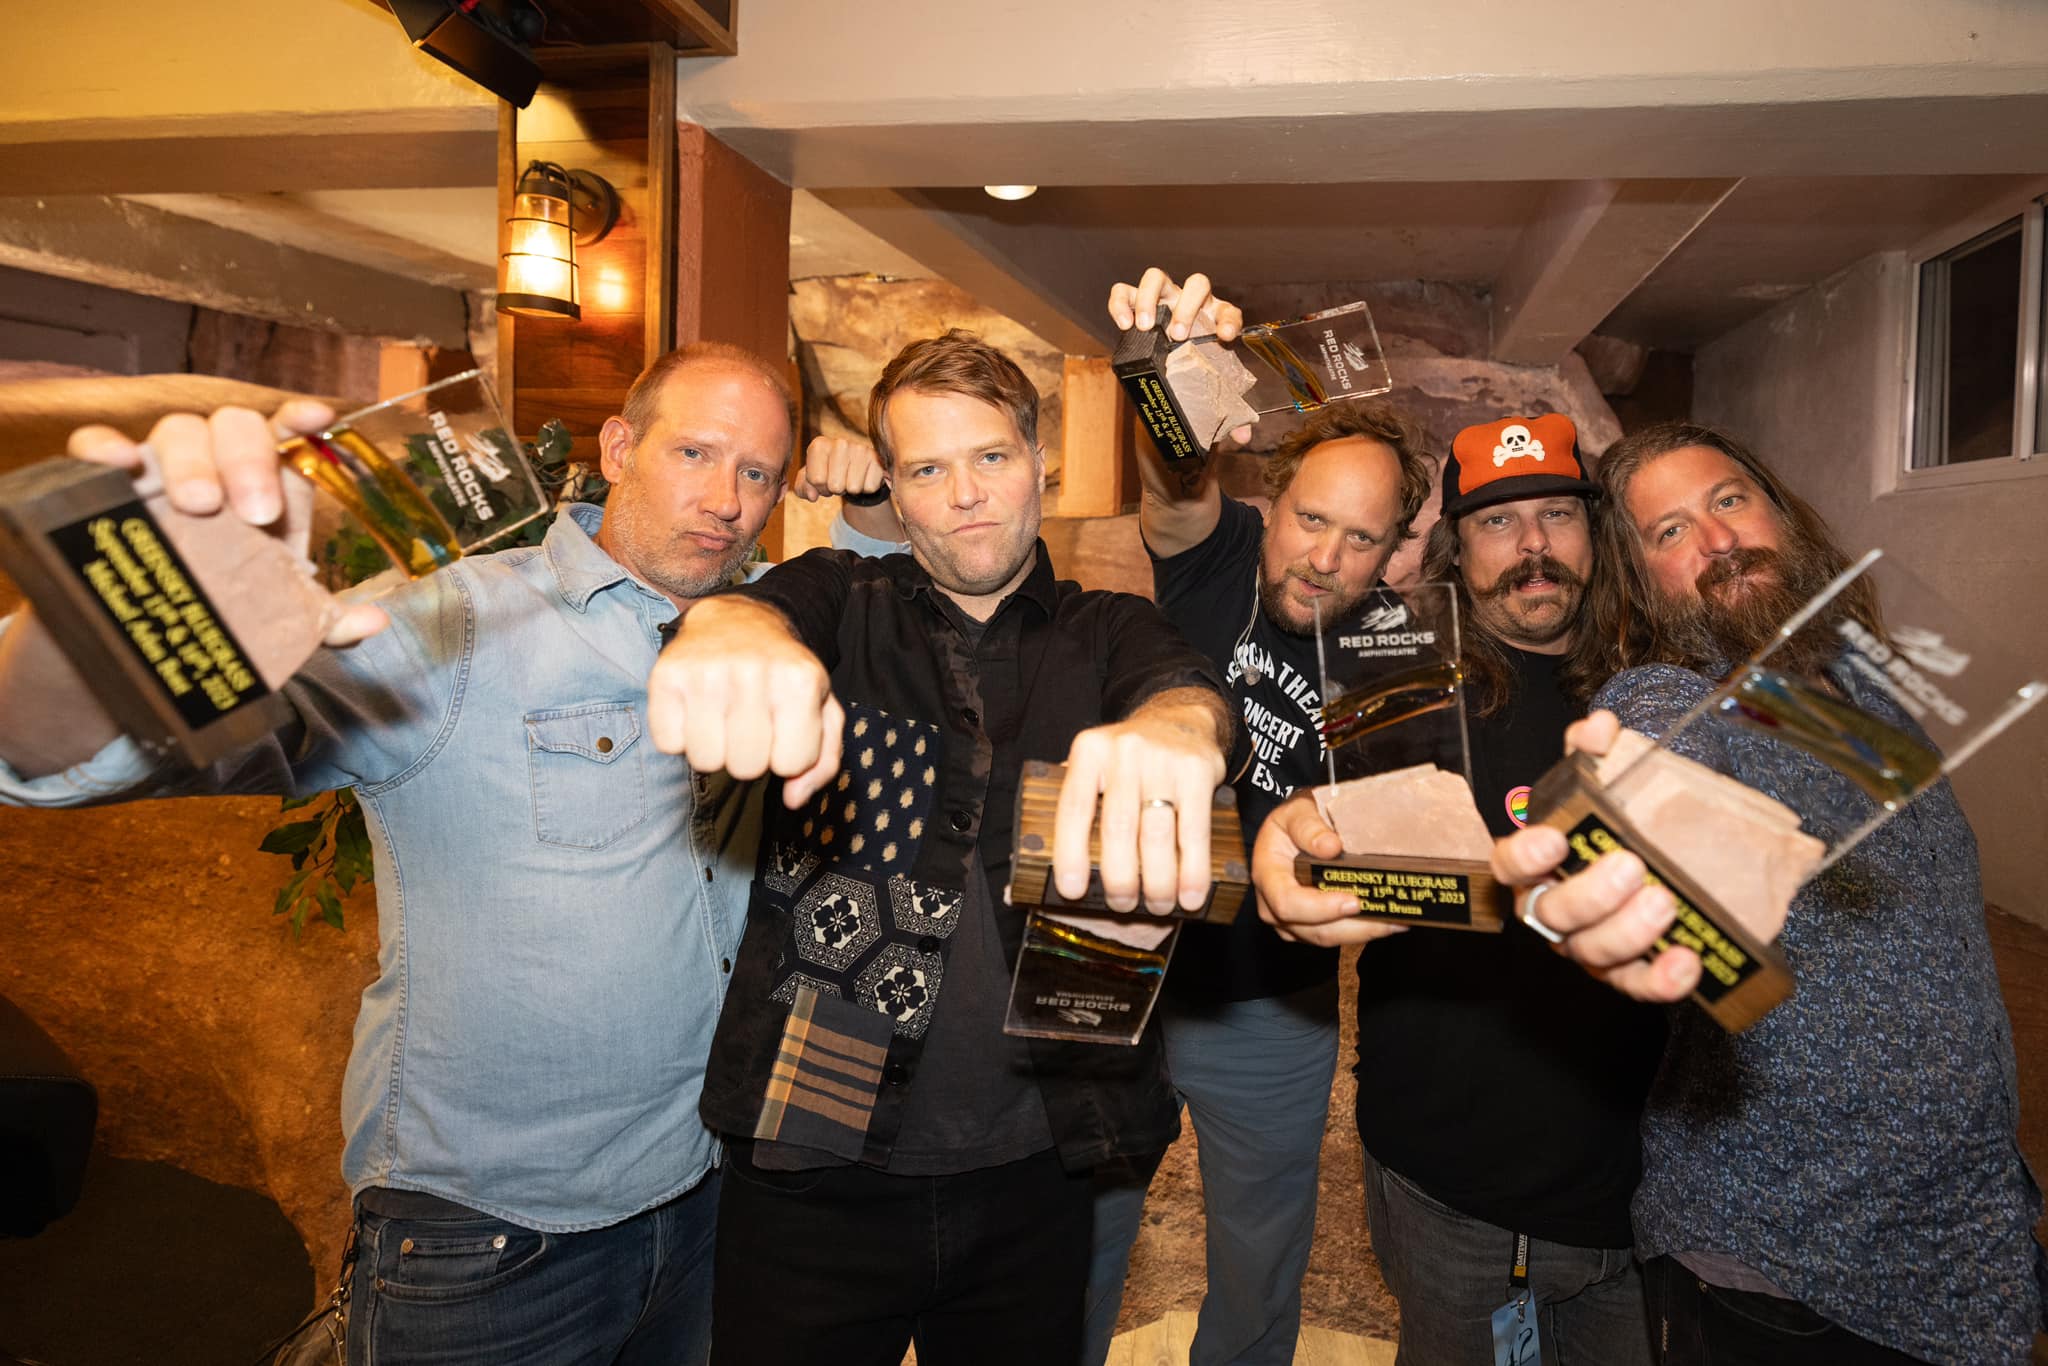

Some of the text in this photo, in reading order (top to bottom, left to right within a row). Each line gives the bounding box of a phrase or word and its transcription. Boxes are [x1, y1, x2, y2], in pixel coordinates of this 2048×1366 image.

[1323, 329, 1352, 390] RED ROCKS
[1138, 377, 1158, 409] September
[1150, 380, 1192, 453] GREENSKY BLUEGRASS
[428, 410, 495, 521] RED ROCKS
[1339, 631, 1435, 649] RED ROCKS
[1358, 647, 1418, 658] AMPHITHEATRE
[1243, 697, 1304, 750] ONCERT
[1323, 869, 1458, 890] GREENSKY BLUEGRASS
[1396, 888, 1409, 901] &
[1439, 891, 1466, 904] 2023
[1516, 1232, 1525, 1266] GATEWA
